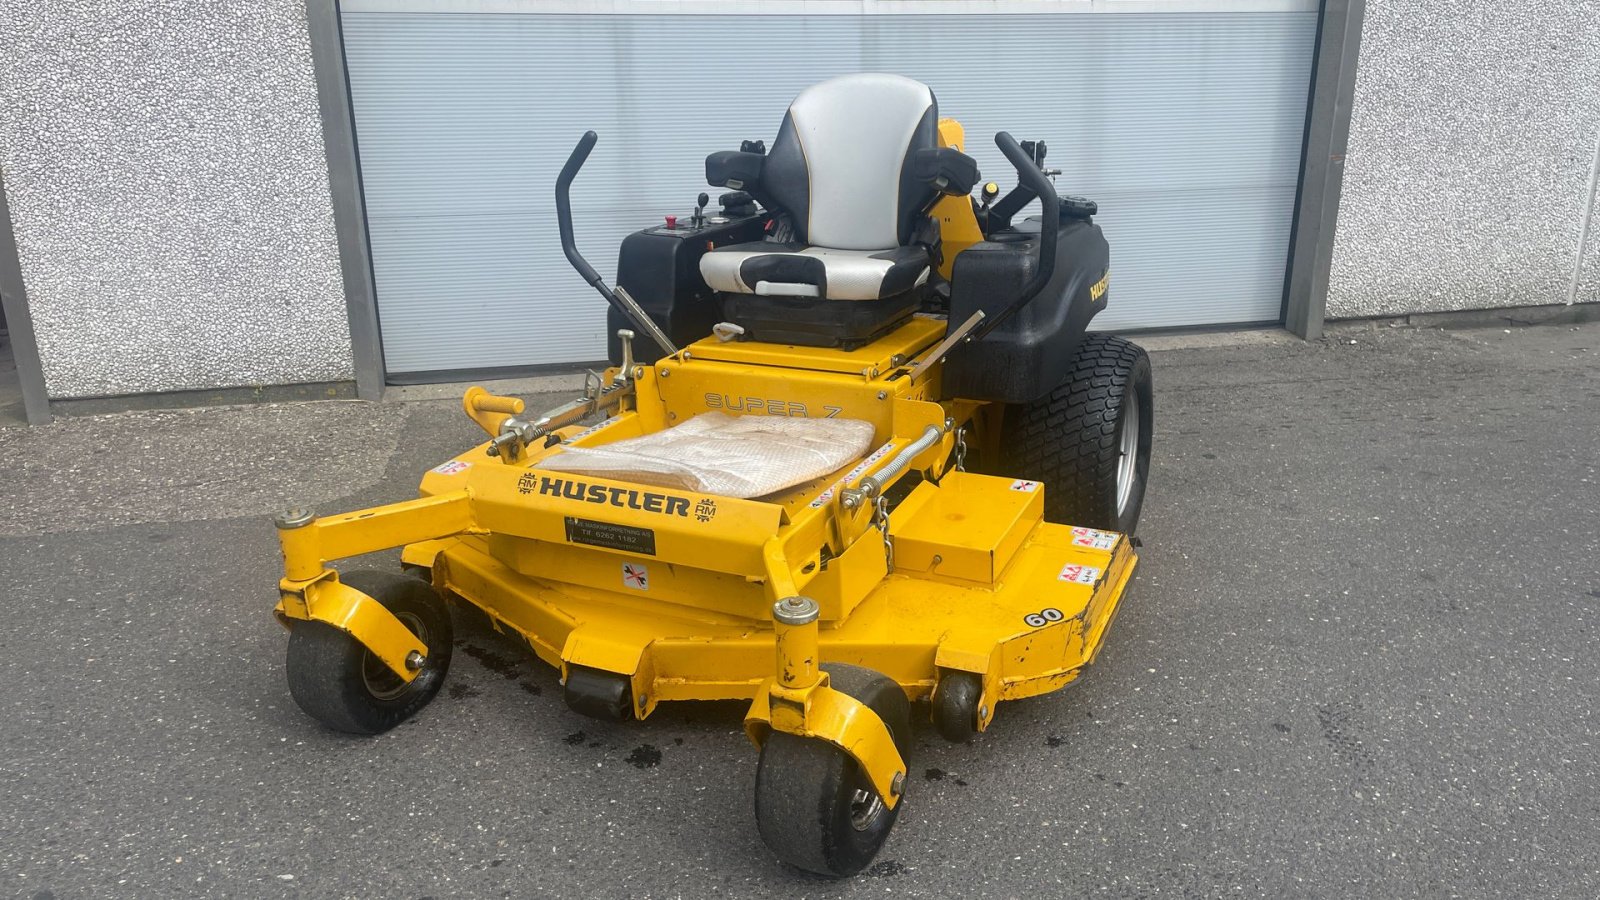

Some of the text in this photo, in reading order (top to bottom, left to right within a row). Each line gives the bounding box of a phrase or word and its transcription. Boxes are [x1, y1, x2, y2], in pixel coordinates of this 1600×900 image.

[704, 392, 843, 418] SUPER Z
[518, 478, 537, 490] RM
[539, 476, 691, 517] HUSTLER
[694, 504, 716, 516] RM
[595, 531, 615, 540] 6262
[1024, 608, 1064, 627] 60
